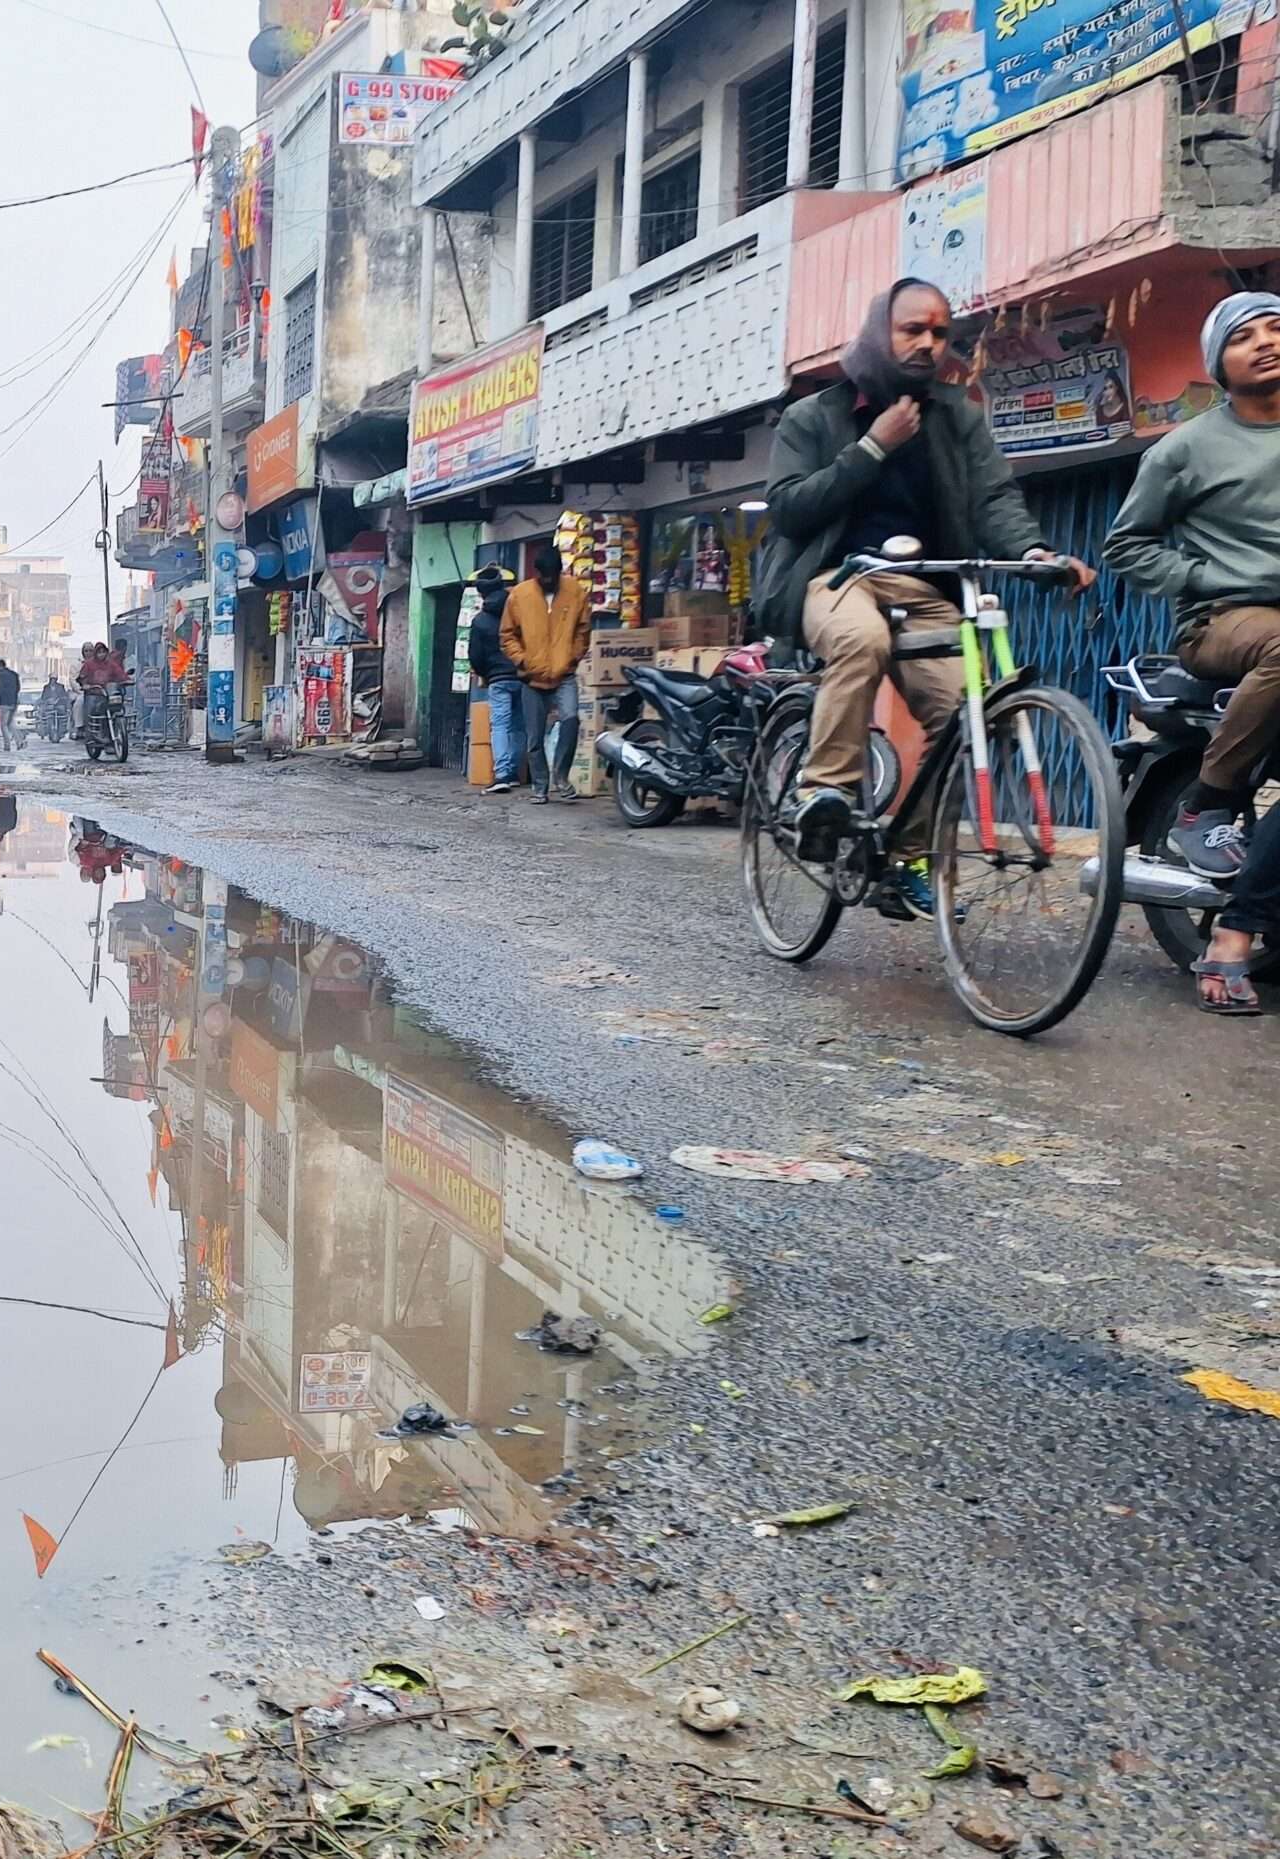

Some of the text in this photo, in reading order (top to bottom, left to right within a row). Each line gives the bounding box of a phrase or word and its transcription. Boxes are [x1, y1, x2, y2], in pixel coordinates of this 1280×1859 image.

[399, 83, 456, 102] STOR
[466, 344, 539, 418] TRADERS
[282, 527, 310, 555] NOKIA
[600, 646, 655, 659] HUGGIES
